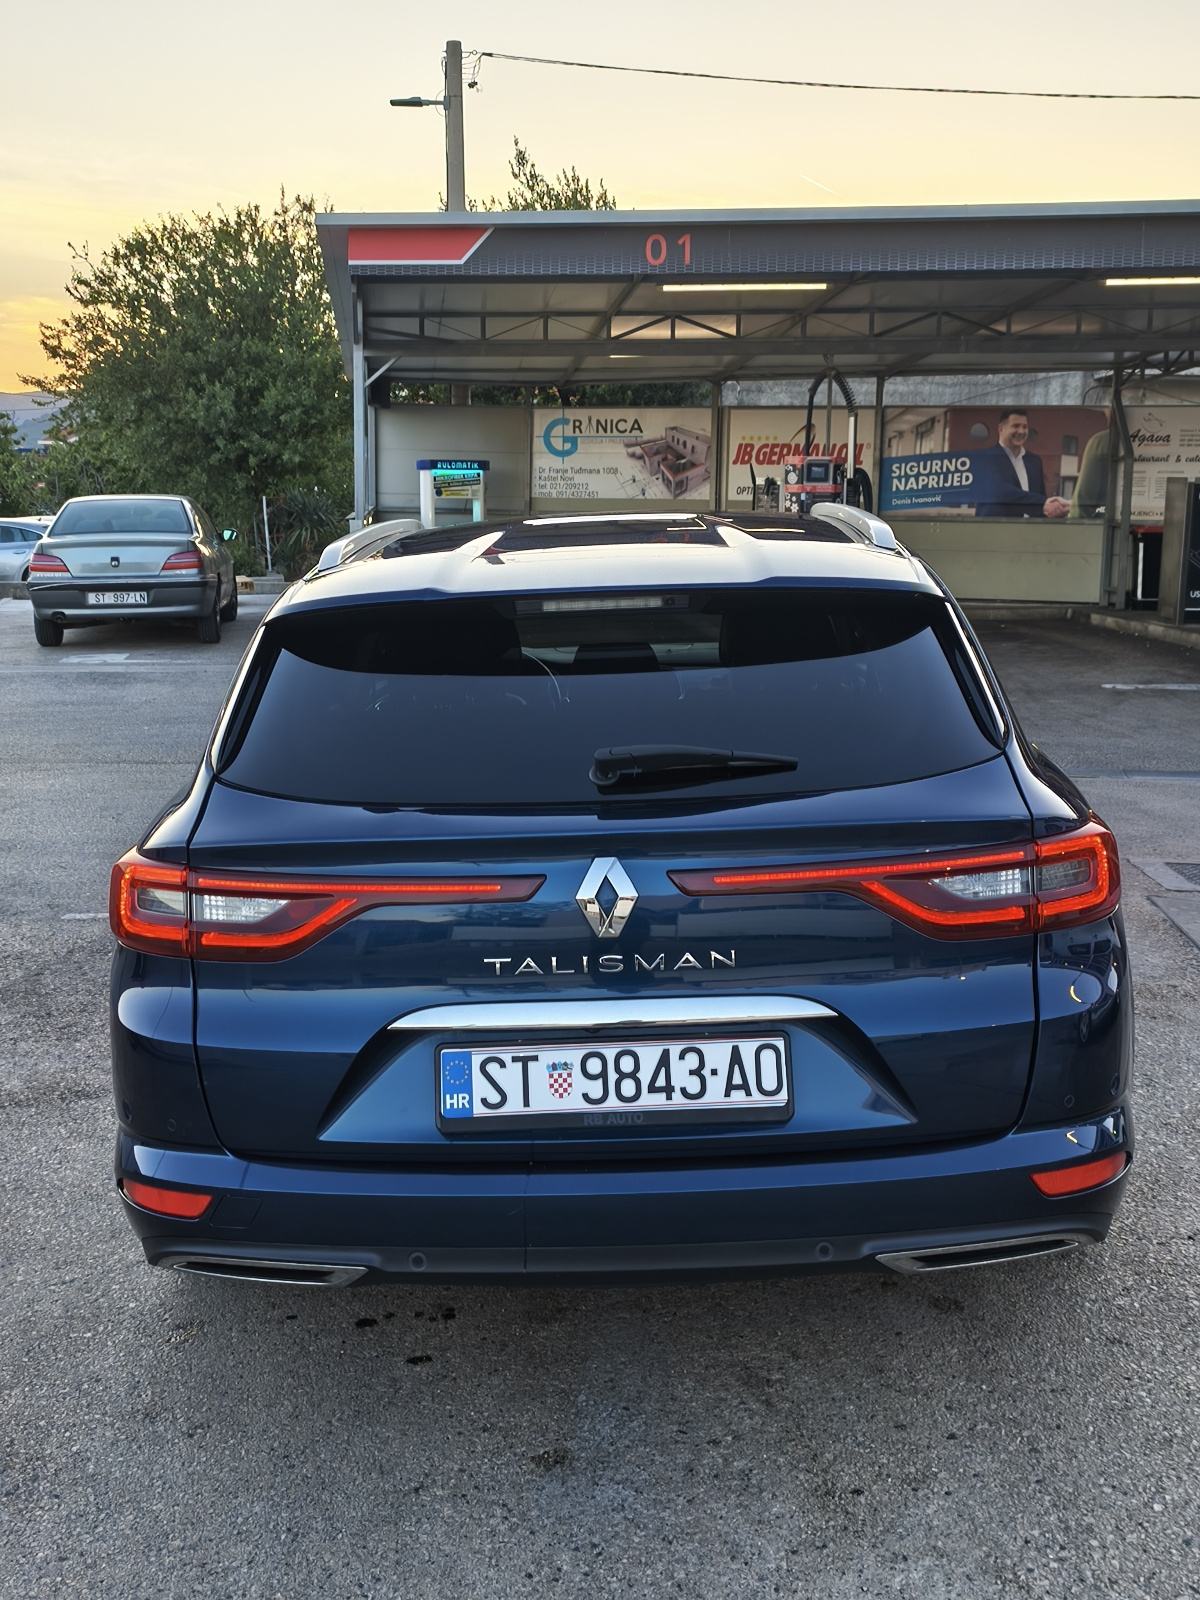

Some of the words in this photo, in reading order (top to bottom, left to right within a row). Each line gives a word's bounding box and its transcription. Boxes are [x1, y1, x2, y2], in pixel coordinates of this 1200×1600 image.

[645, 233, 692, 266] 01
[1129, 429, 1171, 447] Agava
[732, 443, 755, 465] JB
[549, 467, 568, 476] Franje
[891, 457, 971, 477] SIGURNO
[550, 482, 589, 490] 021/209212
[892, 471, 974, 492] NAPRIJED
[892, 497, 911, 505] Denis
[912, 495, 942, 503] Ivanović
[94, 593, 106, 603] ST
[483, 950, 738, 976] TALISMAN
[478, 1054, 540, 1110] ST
[445, 1093, 470, 1110] HR
[607, 1112, 644, 1125] AUTO
